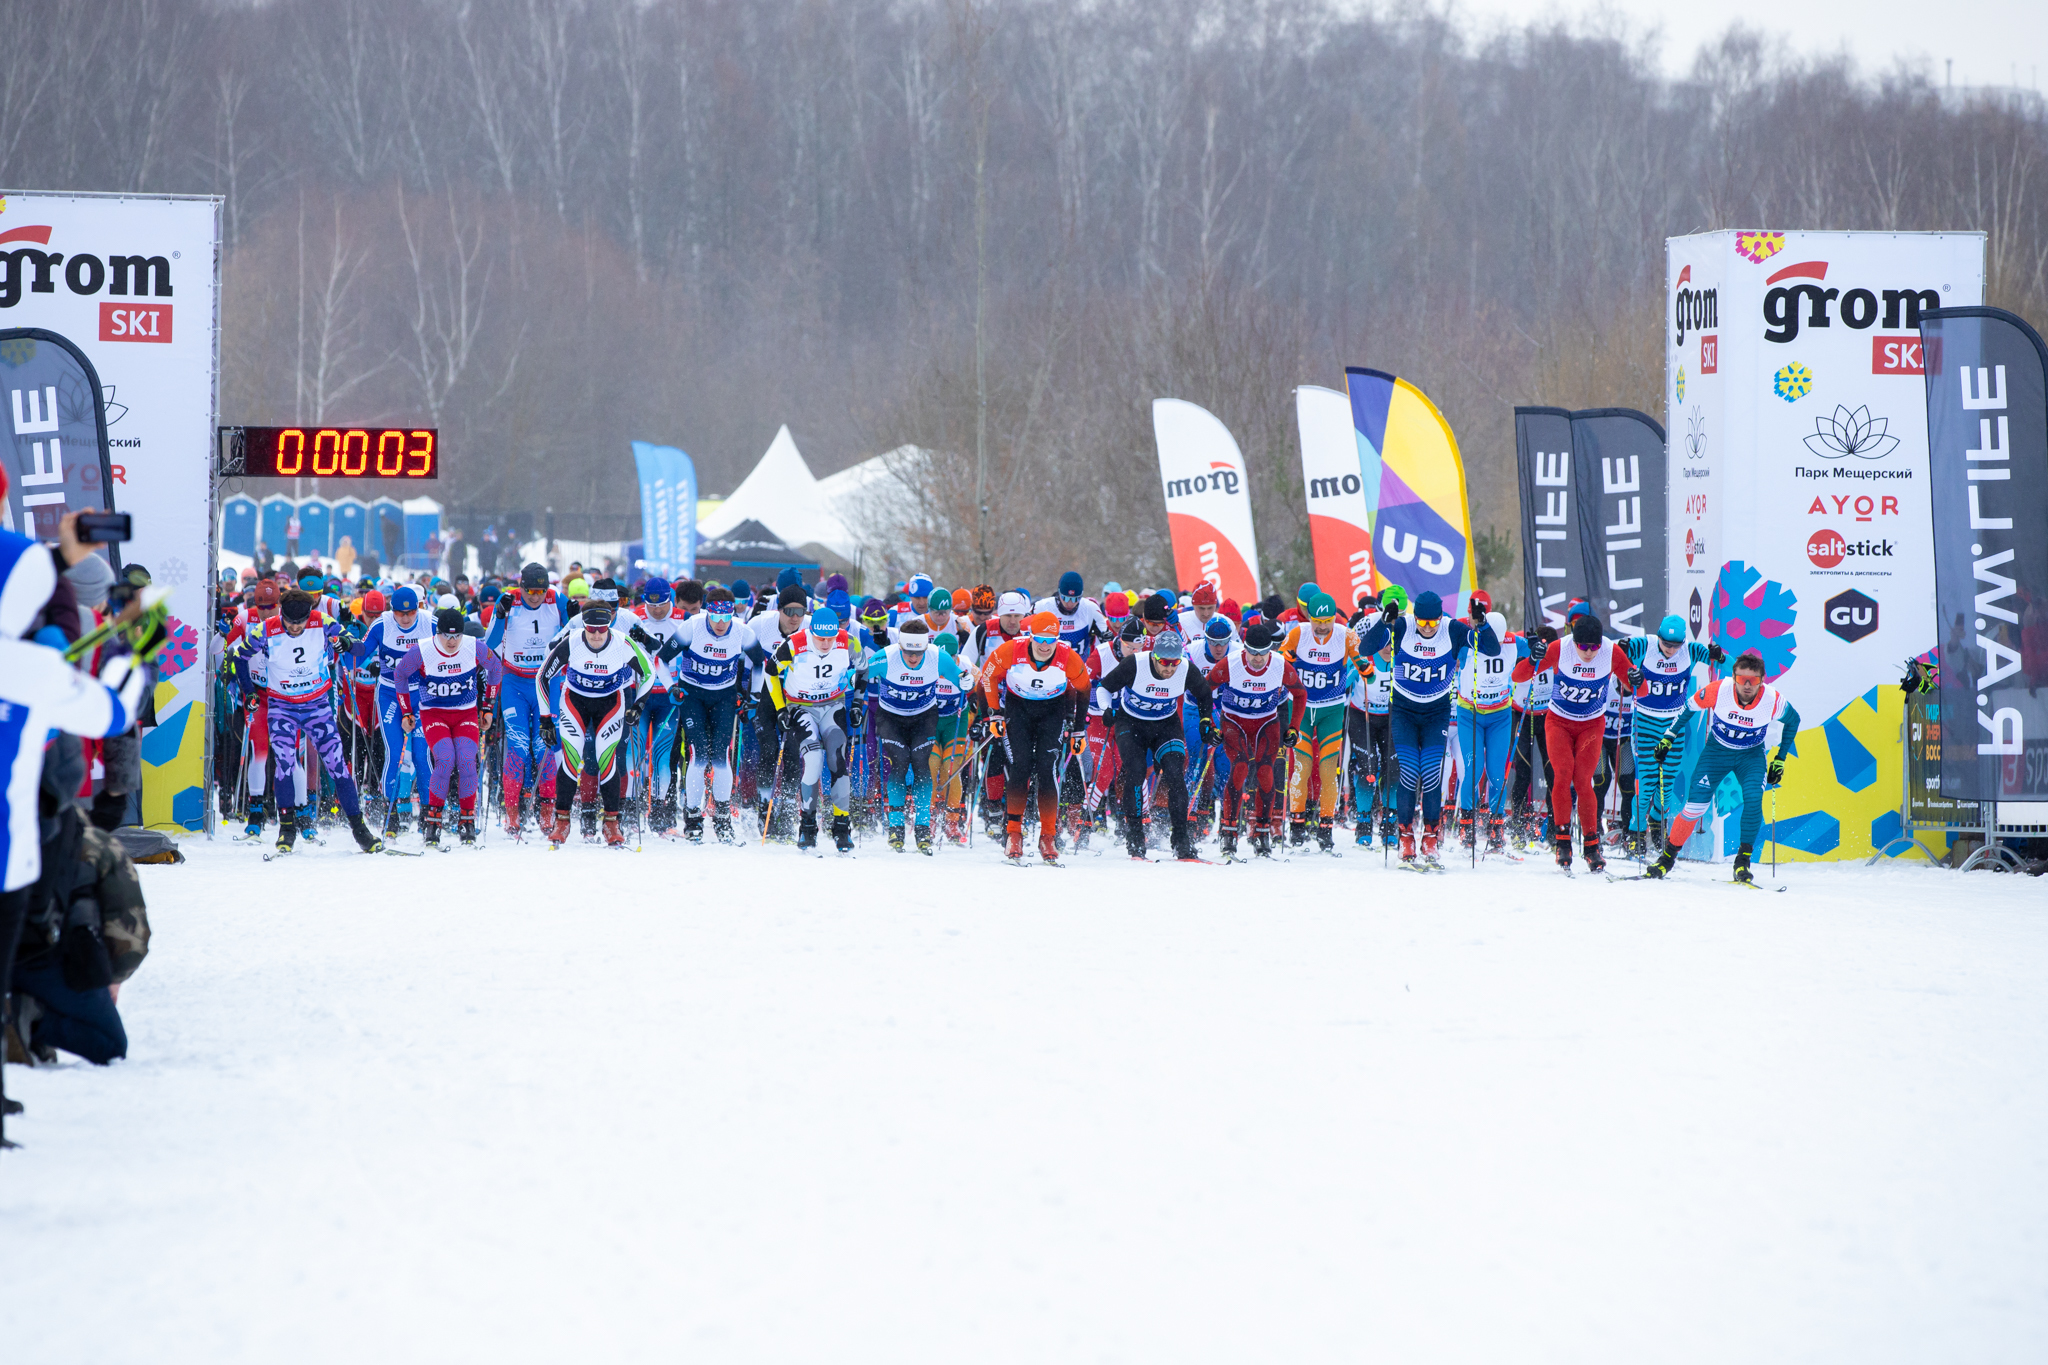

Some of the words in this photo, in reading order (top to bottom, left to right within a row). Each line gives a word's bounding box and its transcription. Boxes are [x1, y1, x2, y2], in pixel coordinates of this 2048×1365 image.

[1675, 287, 1718, 347] grom
[1762, 284, 1940, 343] grom
[111, 310, 160, 337] SKI
[1703, 342, 1715, 368] SKI
[1795, 467, 1829, 480] Парк
[1833, 466, 1913, 481] Мещерский
[1686, 494, 1707, 520] AYOR
[1807, 495, 1899, 521] AYOR
[1807, 538, 1894, 557] saltstick
[1690, 604, 1701, 624] GU
[1829, 606, 1873, 626] GU
[531, 619, 539, 634] 1
[814, 623, 839, 631] LUKOIL
[293, 647, 306, 664] 2
[703, 645, 727, 654] grom
[1308, 650, 1331, 658] grom
[1414, 645, 1436, 653] grom
[513, 653, 543, 663] grom
[437, 662, 461, 672] grom
[584, 662, 608, 670] grom
[813, 664, 833, 679] 12
[1402, 662, 1448, 683] 121-1
[1484, 658, 1504, 674] 10
[1572, 666, 1596, 674] grom
[900, 674, 924, 682] grom
[1297, 668, 1341, 689] 156-1
[1538, 672, 1549, 685] 9
[1379, 679, 1391, 693] 5
[1559, 681, 1604, 704] 222-1
[1728, 712, 1754, 724] grom
